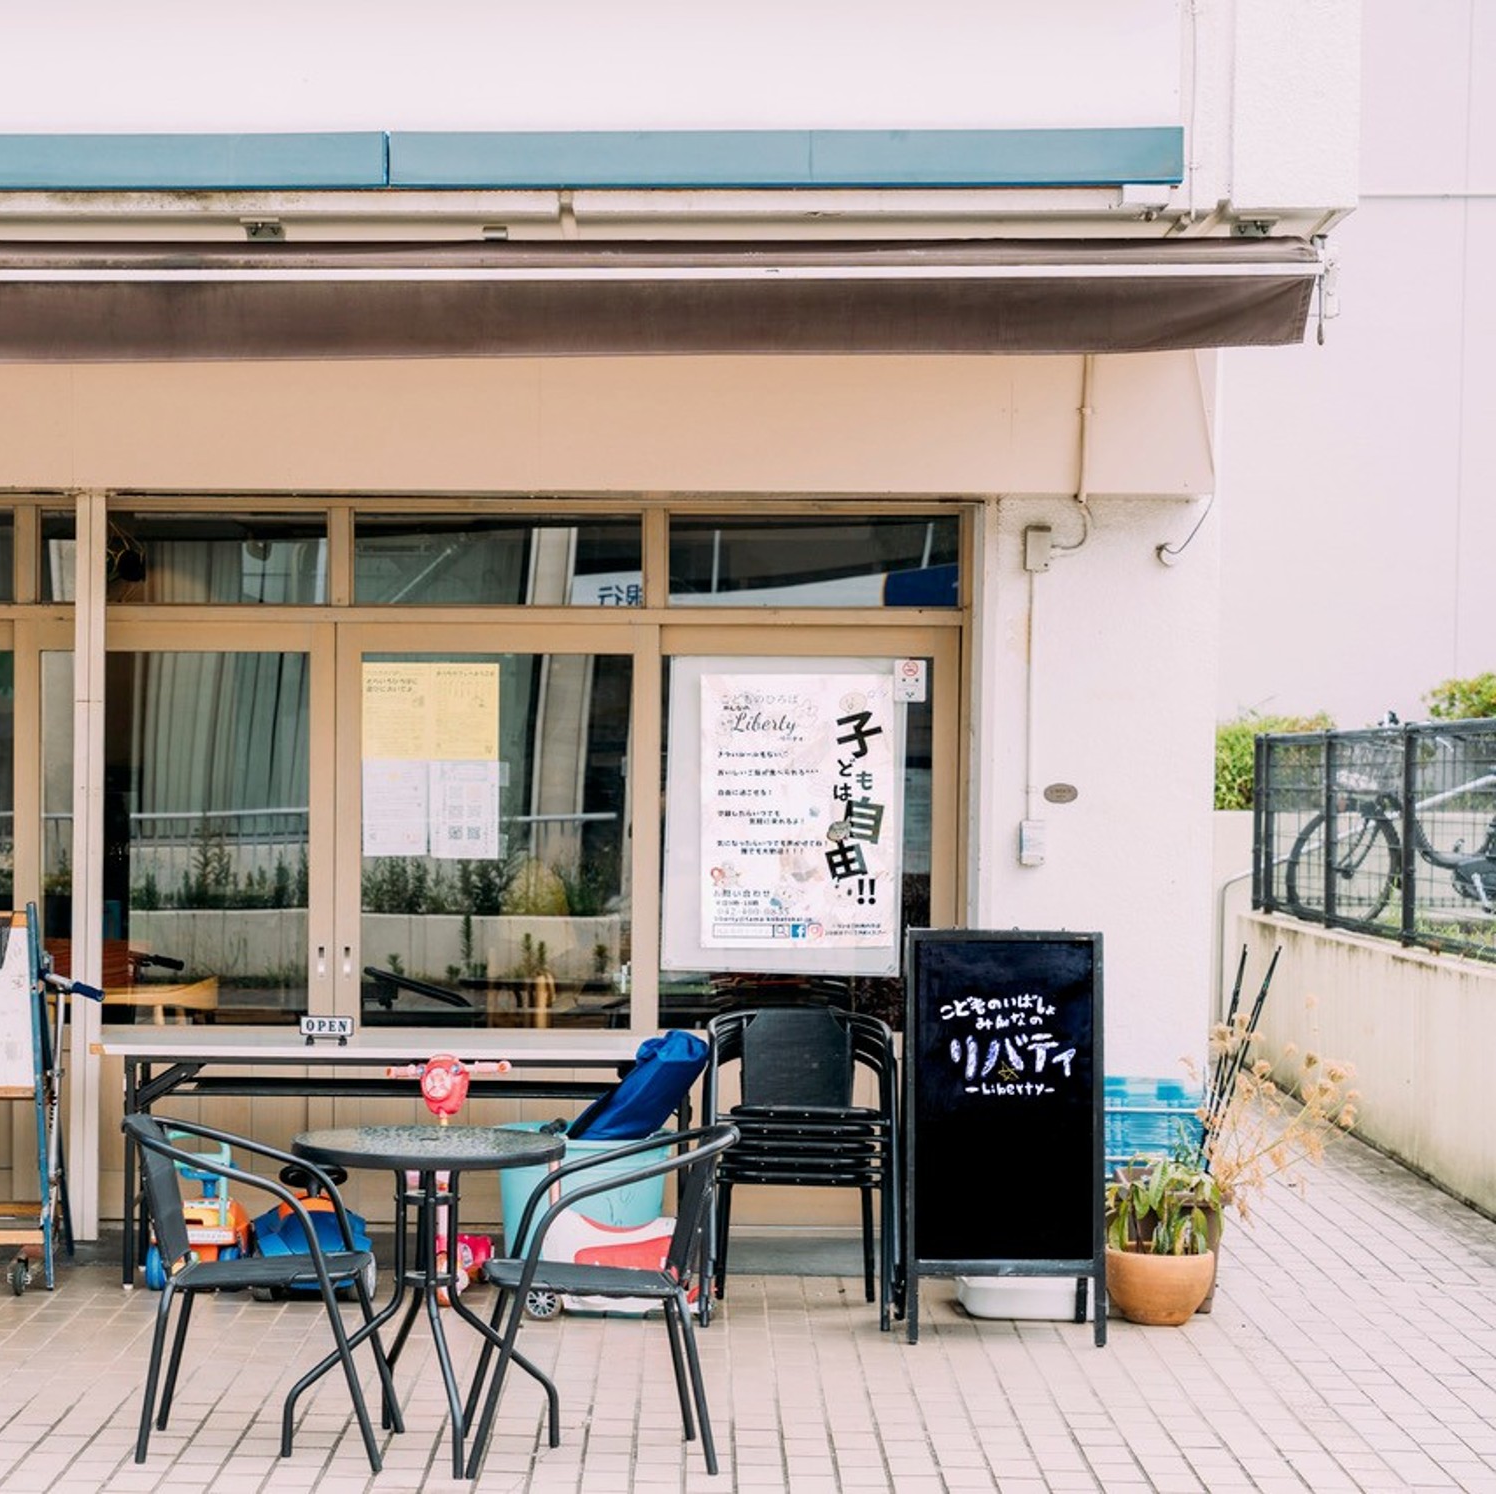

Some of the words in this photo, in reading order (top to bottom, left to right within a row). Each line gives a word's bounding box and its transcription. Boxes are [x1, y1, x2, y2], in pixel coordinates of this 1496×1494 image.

[732, 712, 796, 735] Liberty
[940, 993, 1056, 1020] こどものいばしょ
[306, 1020, 348, 1033] OPEN
[975, 1012, 1043, 1030] みんなの
[950, 1034, 1076, 1081] リバティ
